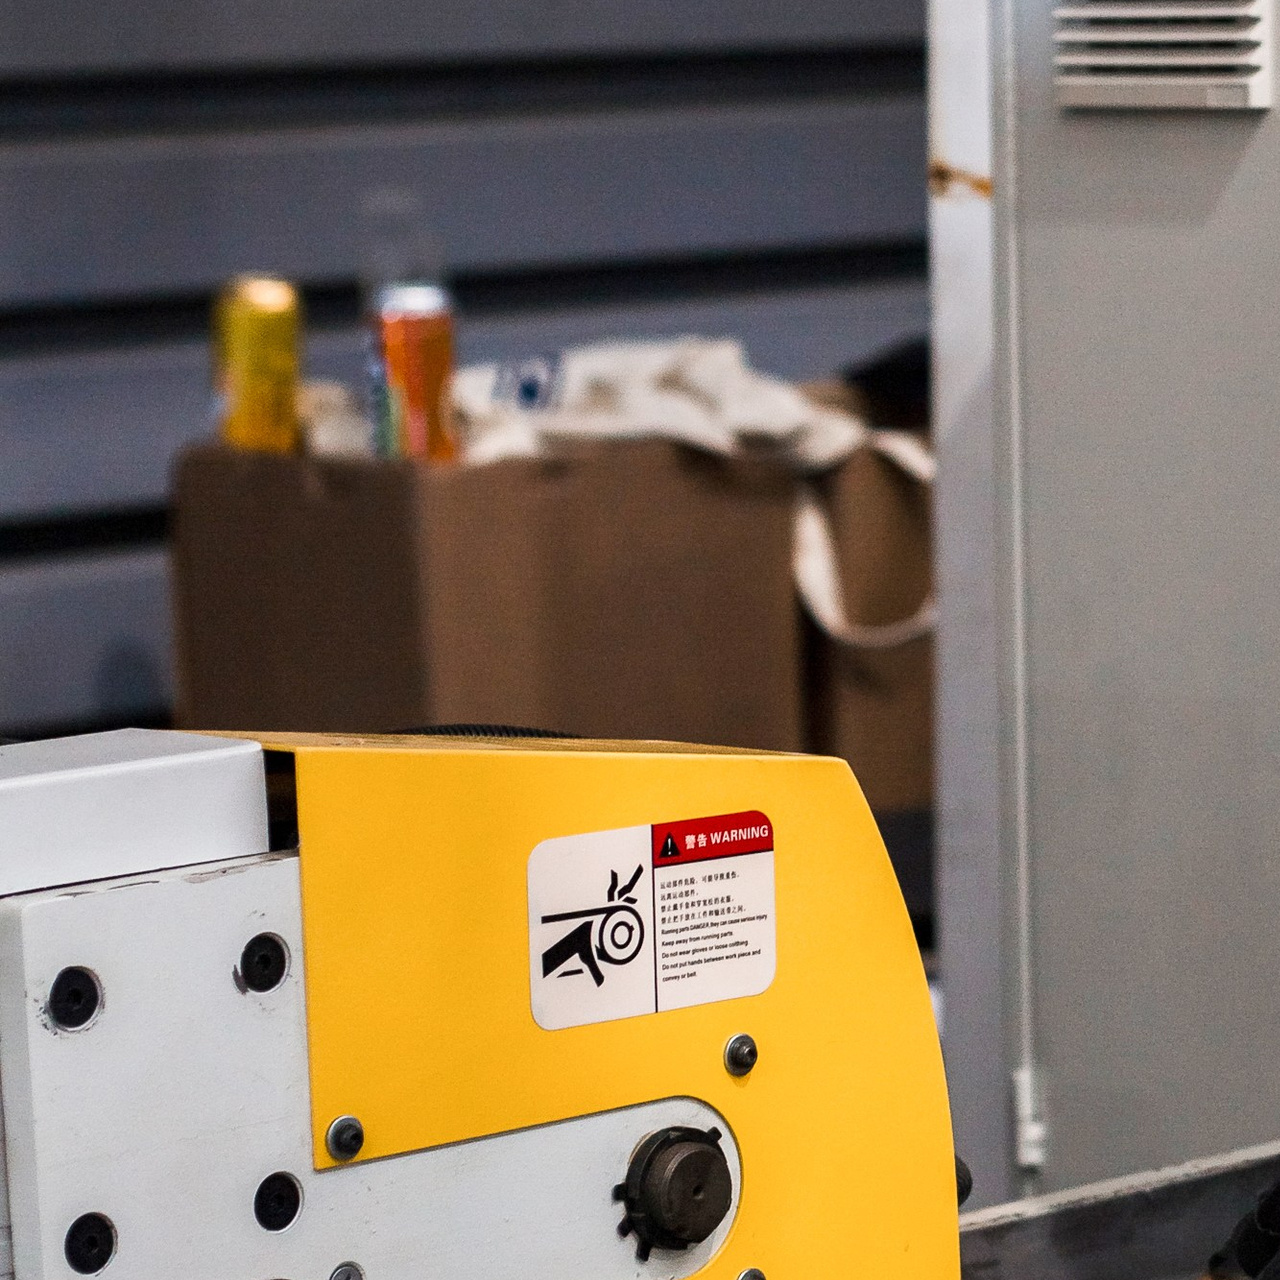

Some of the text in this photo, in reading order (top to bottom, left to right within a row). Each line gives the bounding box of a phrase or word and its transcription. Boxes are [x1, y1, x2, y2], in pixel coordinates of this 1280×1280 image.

[685, 825, 769, 850] 警告 WARNING
[701, 932, 720, 940] running
[691, 946, 708, 954] gloves
[688, 958, 703, 966] hands
[704, 956, 724, 964] between
[662, 974, 680, 982] convey
